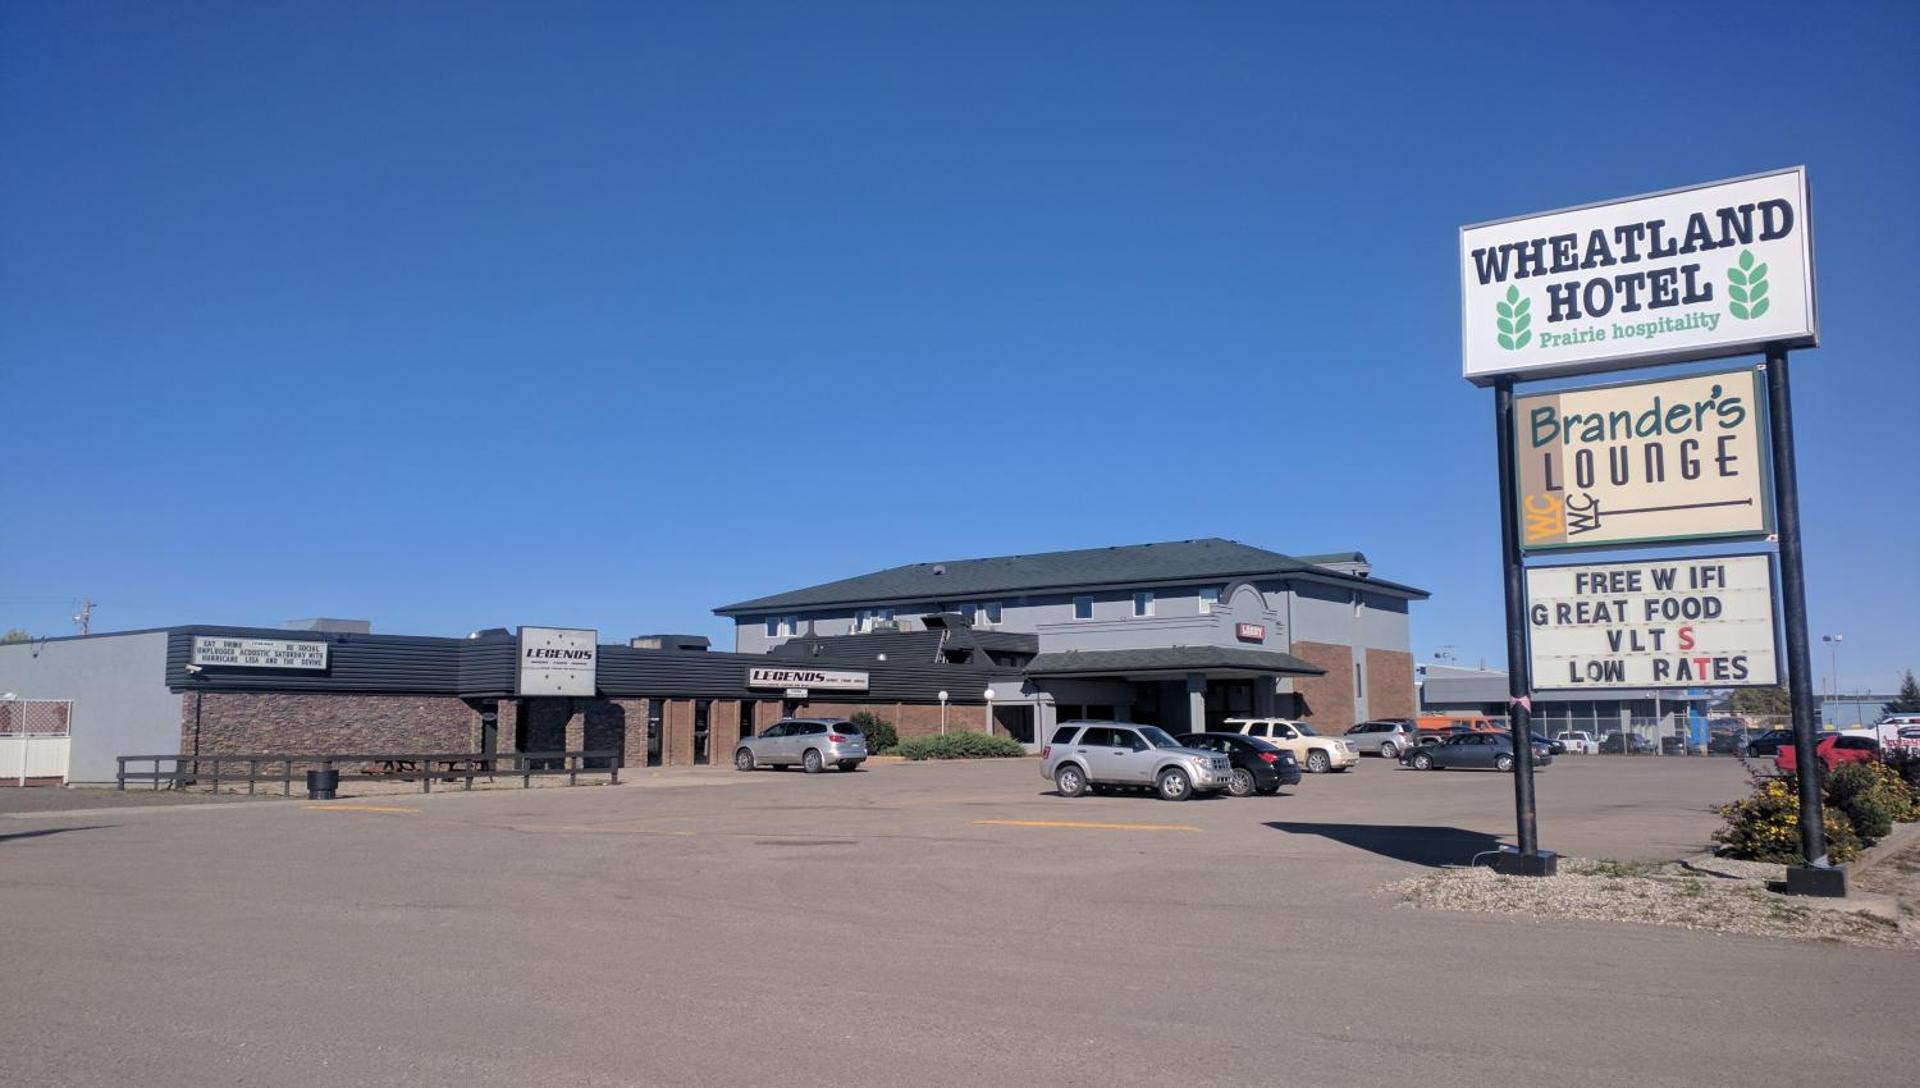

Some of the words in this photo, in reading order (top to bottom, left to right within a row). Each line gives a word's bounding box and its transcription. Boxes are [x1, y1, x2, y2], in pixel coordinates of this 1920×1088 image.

[1471, 198, 1794, 286] WHEATLAND
[1546, 264, 1713, 323] HOTEL
[1539, 327, 1606, 349] Prairie
[1612, 311, 1721, 341] hospitality
[1530, 384, 1746, 449] Brander's
[1544, 434, 1739, 492] LOUNGE
[1575, 569, 1642, 595] FREE
[1531, 599, 1628, 626] GREAT
[1644, 596, 1722, 622] FOOD
[526, 648, 593, 660] LEGENDS
[1569, 659, 1625, 683] LOW
[1652, 655, 1748, 682] RATES
[753, 670, 826, 682] LEGENDS
